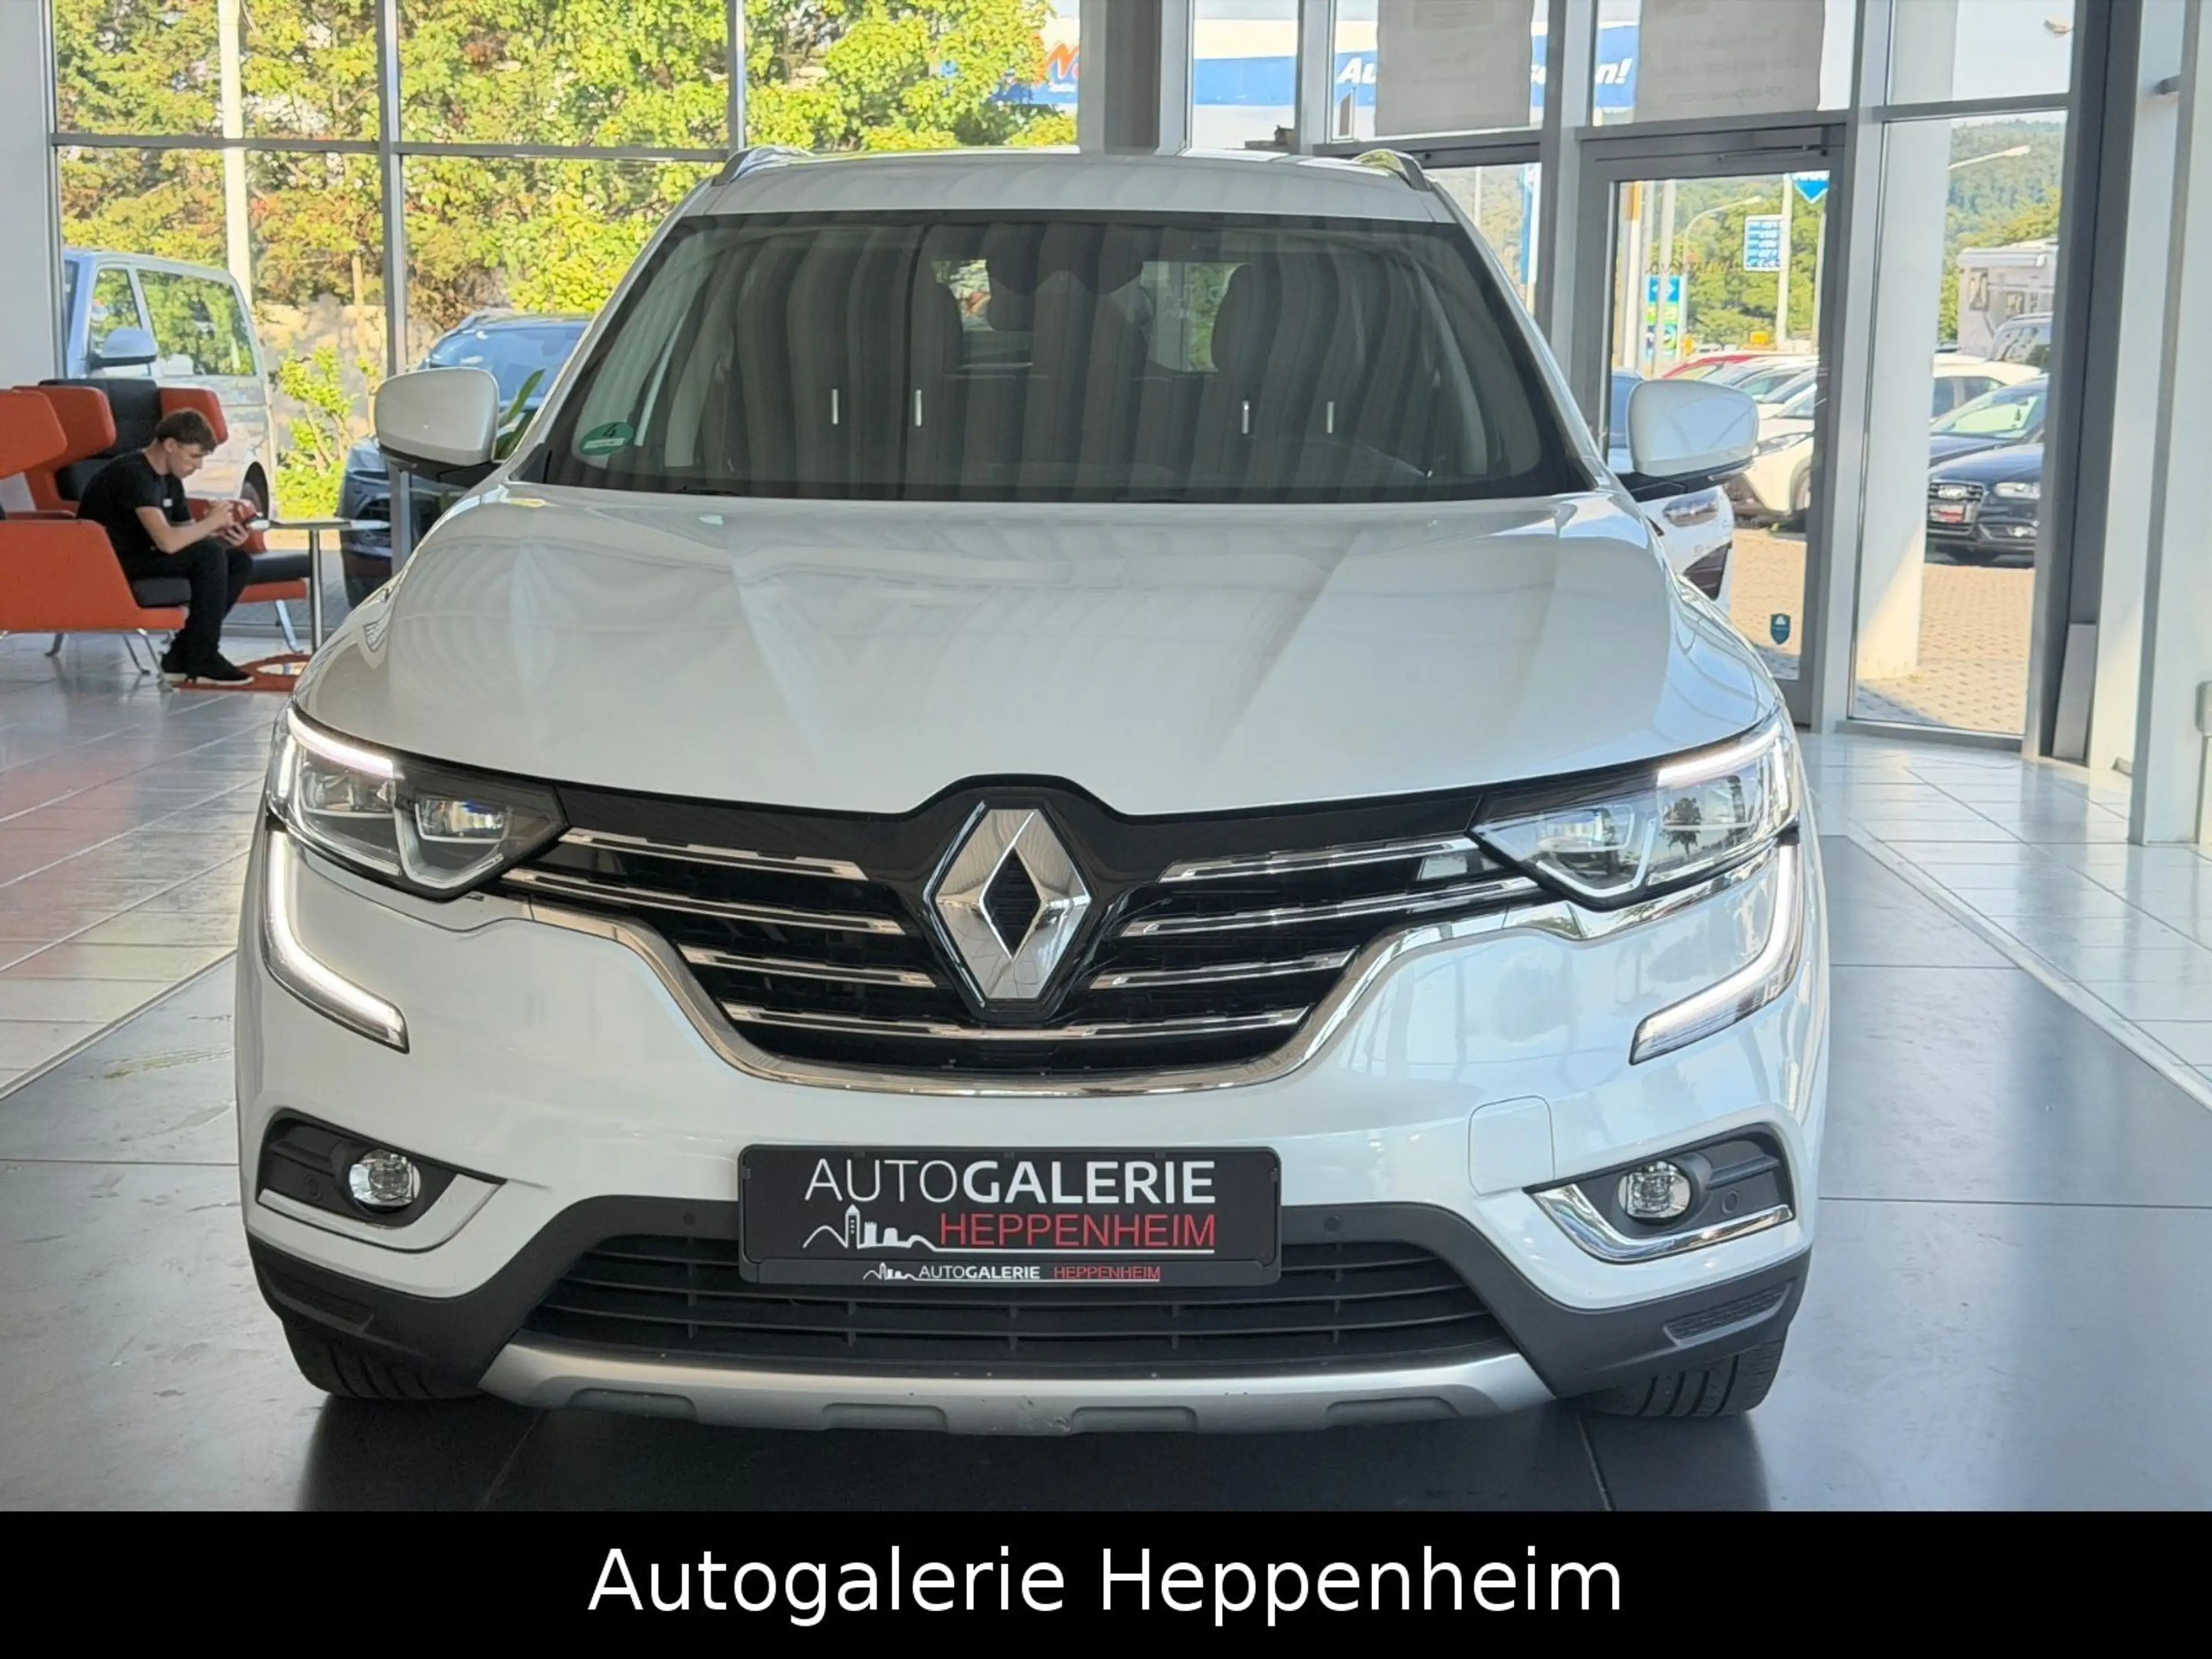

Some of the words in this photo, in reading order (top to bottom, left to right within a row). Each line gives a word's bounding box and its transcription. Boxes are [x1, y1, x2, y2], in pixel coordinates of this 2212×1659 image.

[805, 1158, 1215, 1203] AUTOGALERIE
[940, 1213, 1215, 1247] HEPPENHEIM
[919, 1265, 1041, 1279] AUTOGALERIE
[1054, 1266, 1161, 1280] HEPPENHEIM
